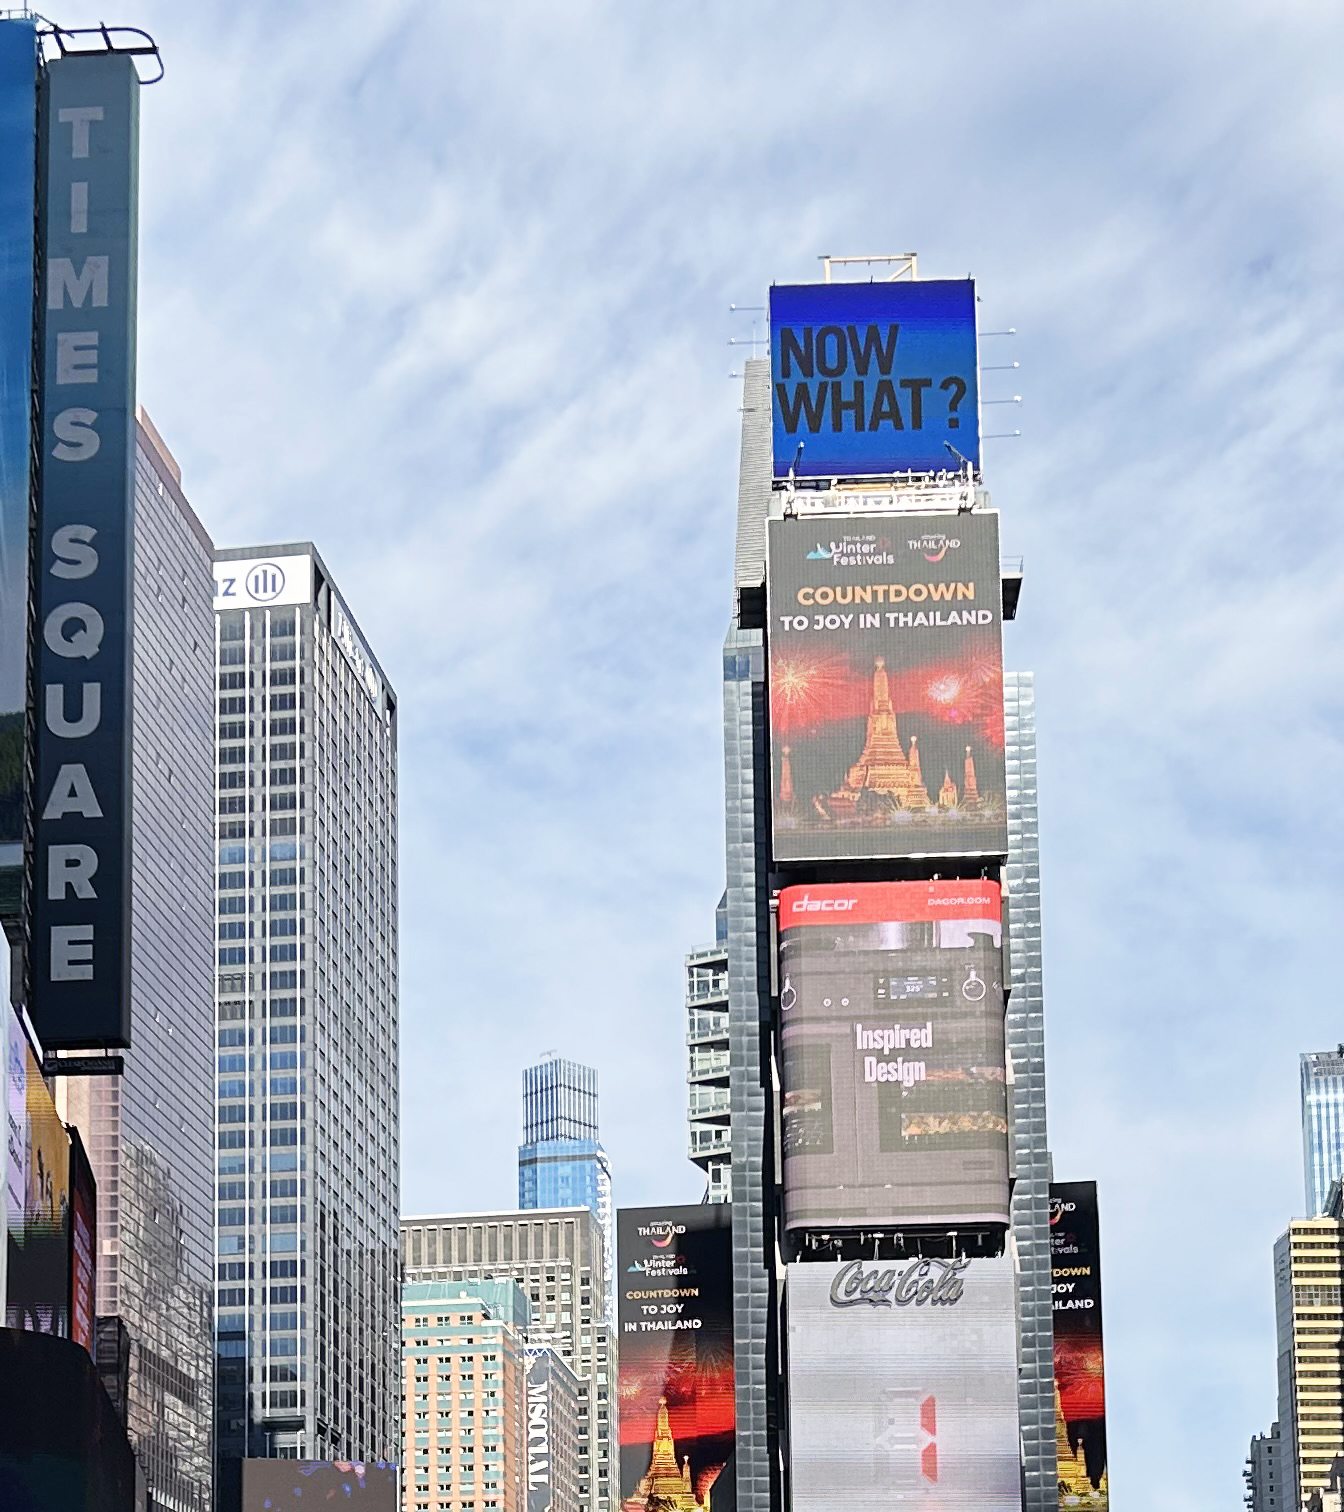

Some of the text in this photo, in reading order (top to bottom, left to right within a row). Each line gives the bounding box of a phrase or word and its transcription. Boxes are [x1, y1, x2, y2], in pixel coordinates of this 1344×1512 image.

[47, 105, 109, 462] TIMES
[780, 323, 899, 378] NOW
[833, 552, 894, 566] Festivals
[797, 582, 975, 606] COUNTDOWN
[780, 609, 993, 631] TO JOY IN THAILAND
[42, 523, 105, 982] SQUARE
[792, 894, 991, 913] dacor DACOR.COM
[856, 1022, 933, 1055] Inspired
[864, 1056, 926, 1086] Design
[645, 1266, 688, 1277] Festivals
[626, 1288, 699, 1300] COUNTDOWN
[641, 1303, 684, 1315] TO JOY
[624, 1319, 702, 1332] IN THAILAND
